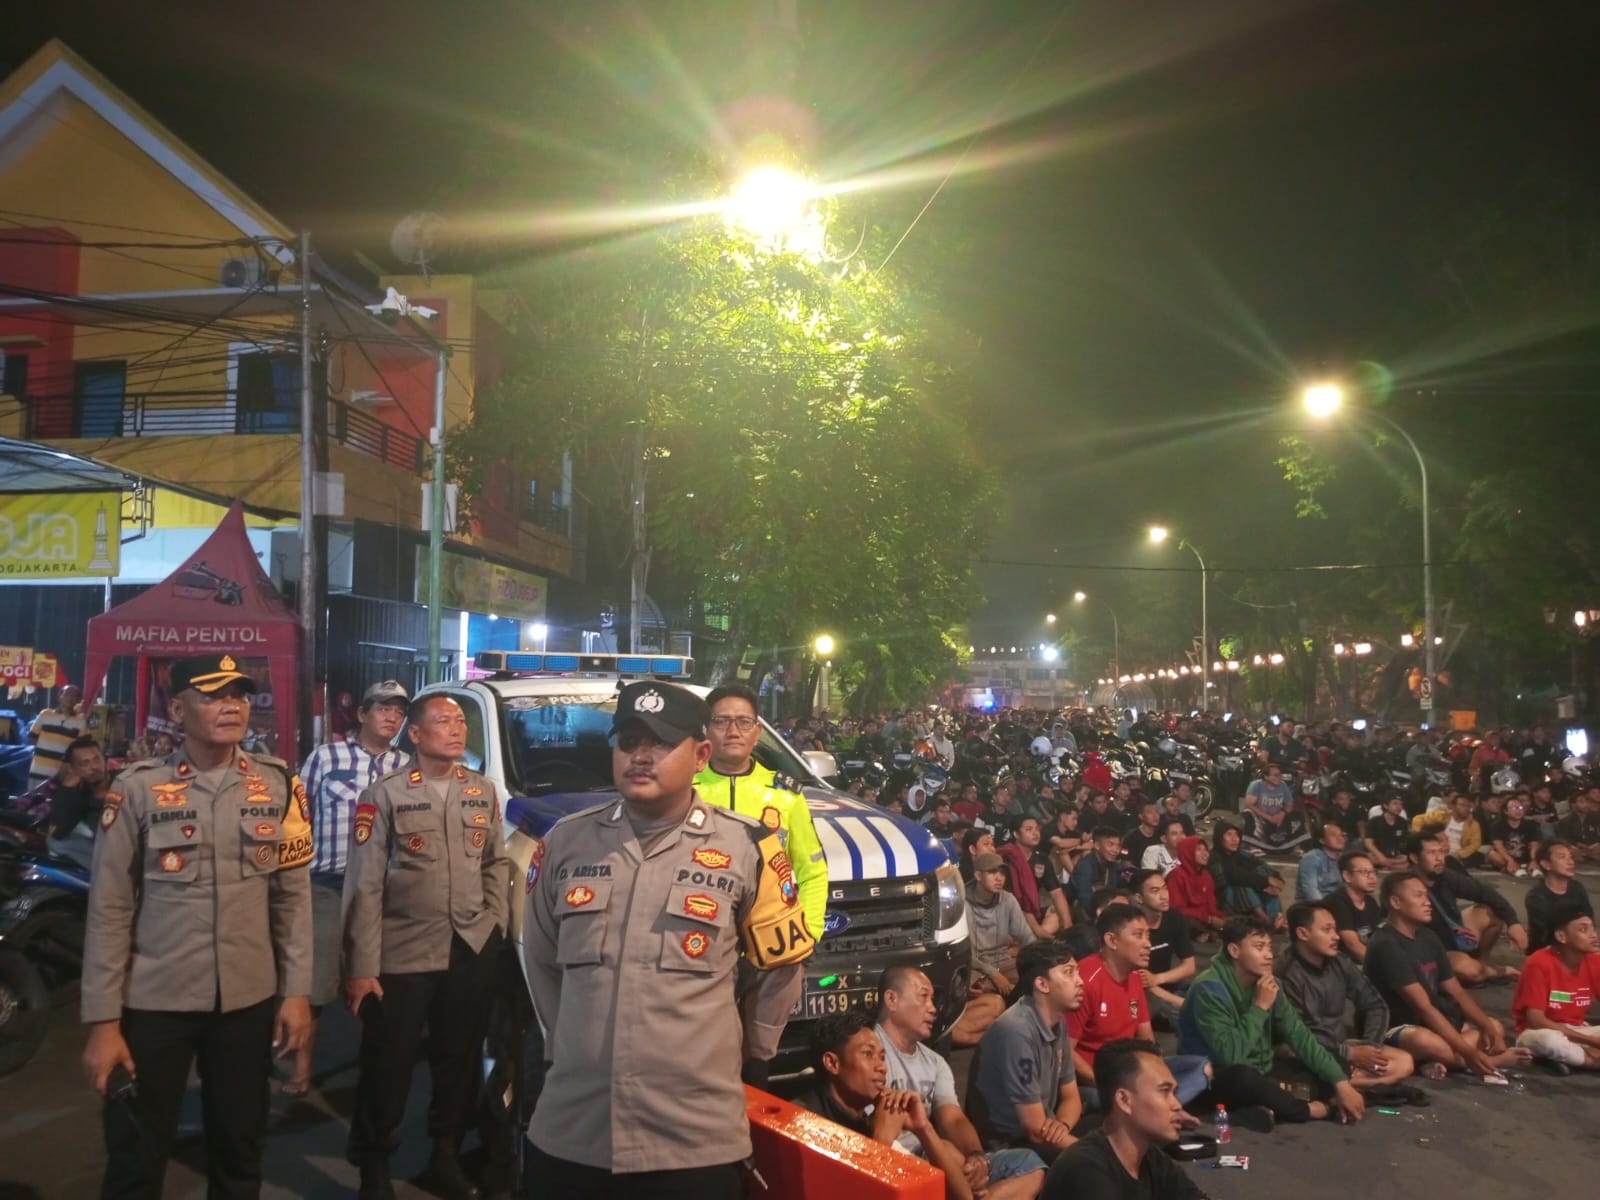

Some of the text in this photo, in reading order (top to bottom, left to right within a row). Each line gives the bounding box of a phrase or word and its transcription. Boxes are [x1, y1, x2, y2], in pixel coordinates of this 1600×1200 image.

[116, 625, 267, 642] MAFIA PENTOL
[241, 807, 280, 817] POLRI
[572, 864, 613, 879] ARISTA
[677, 869, 735, 892] POLRI
